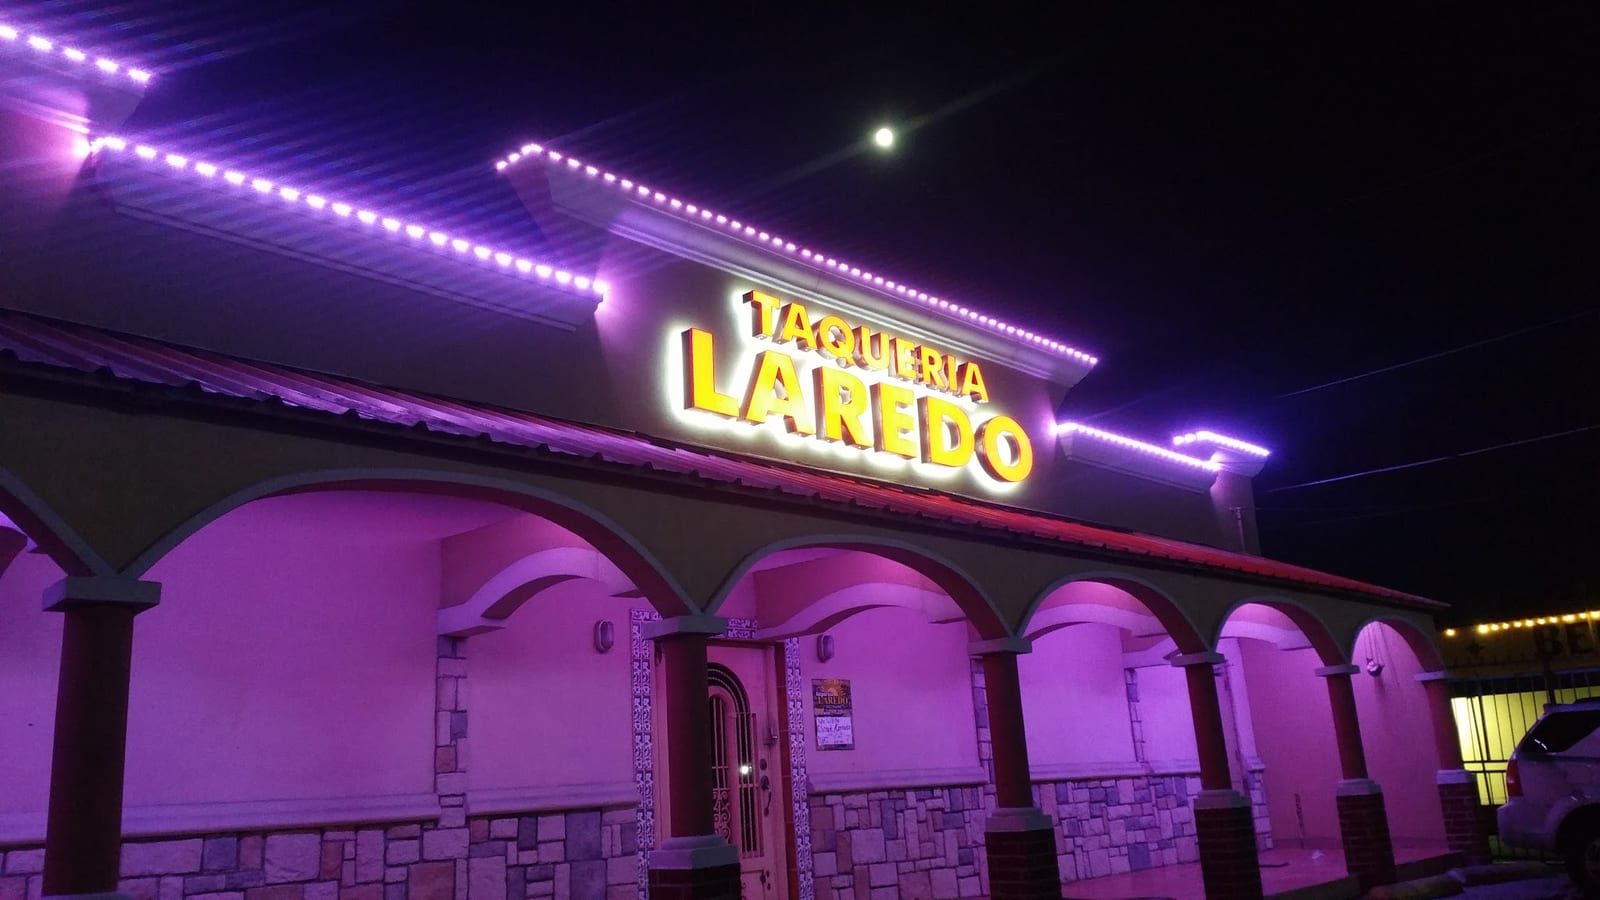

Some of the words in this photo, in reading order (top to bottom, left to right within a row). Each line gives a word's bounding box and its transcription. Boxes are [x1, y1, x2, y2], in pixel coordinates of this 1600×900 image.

[743, 289, 989, 402] TAQUERIA
[682, 327, 1034, 482] LAREDO
[1535, 622, 1600, 656] BE
[817, 696, 849, 705] LAREDO
